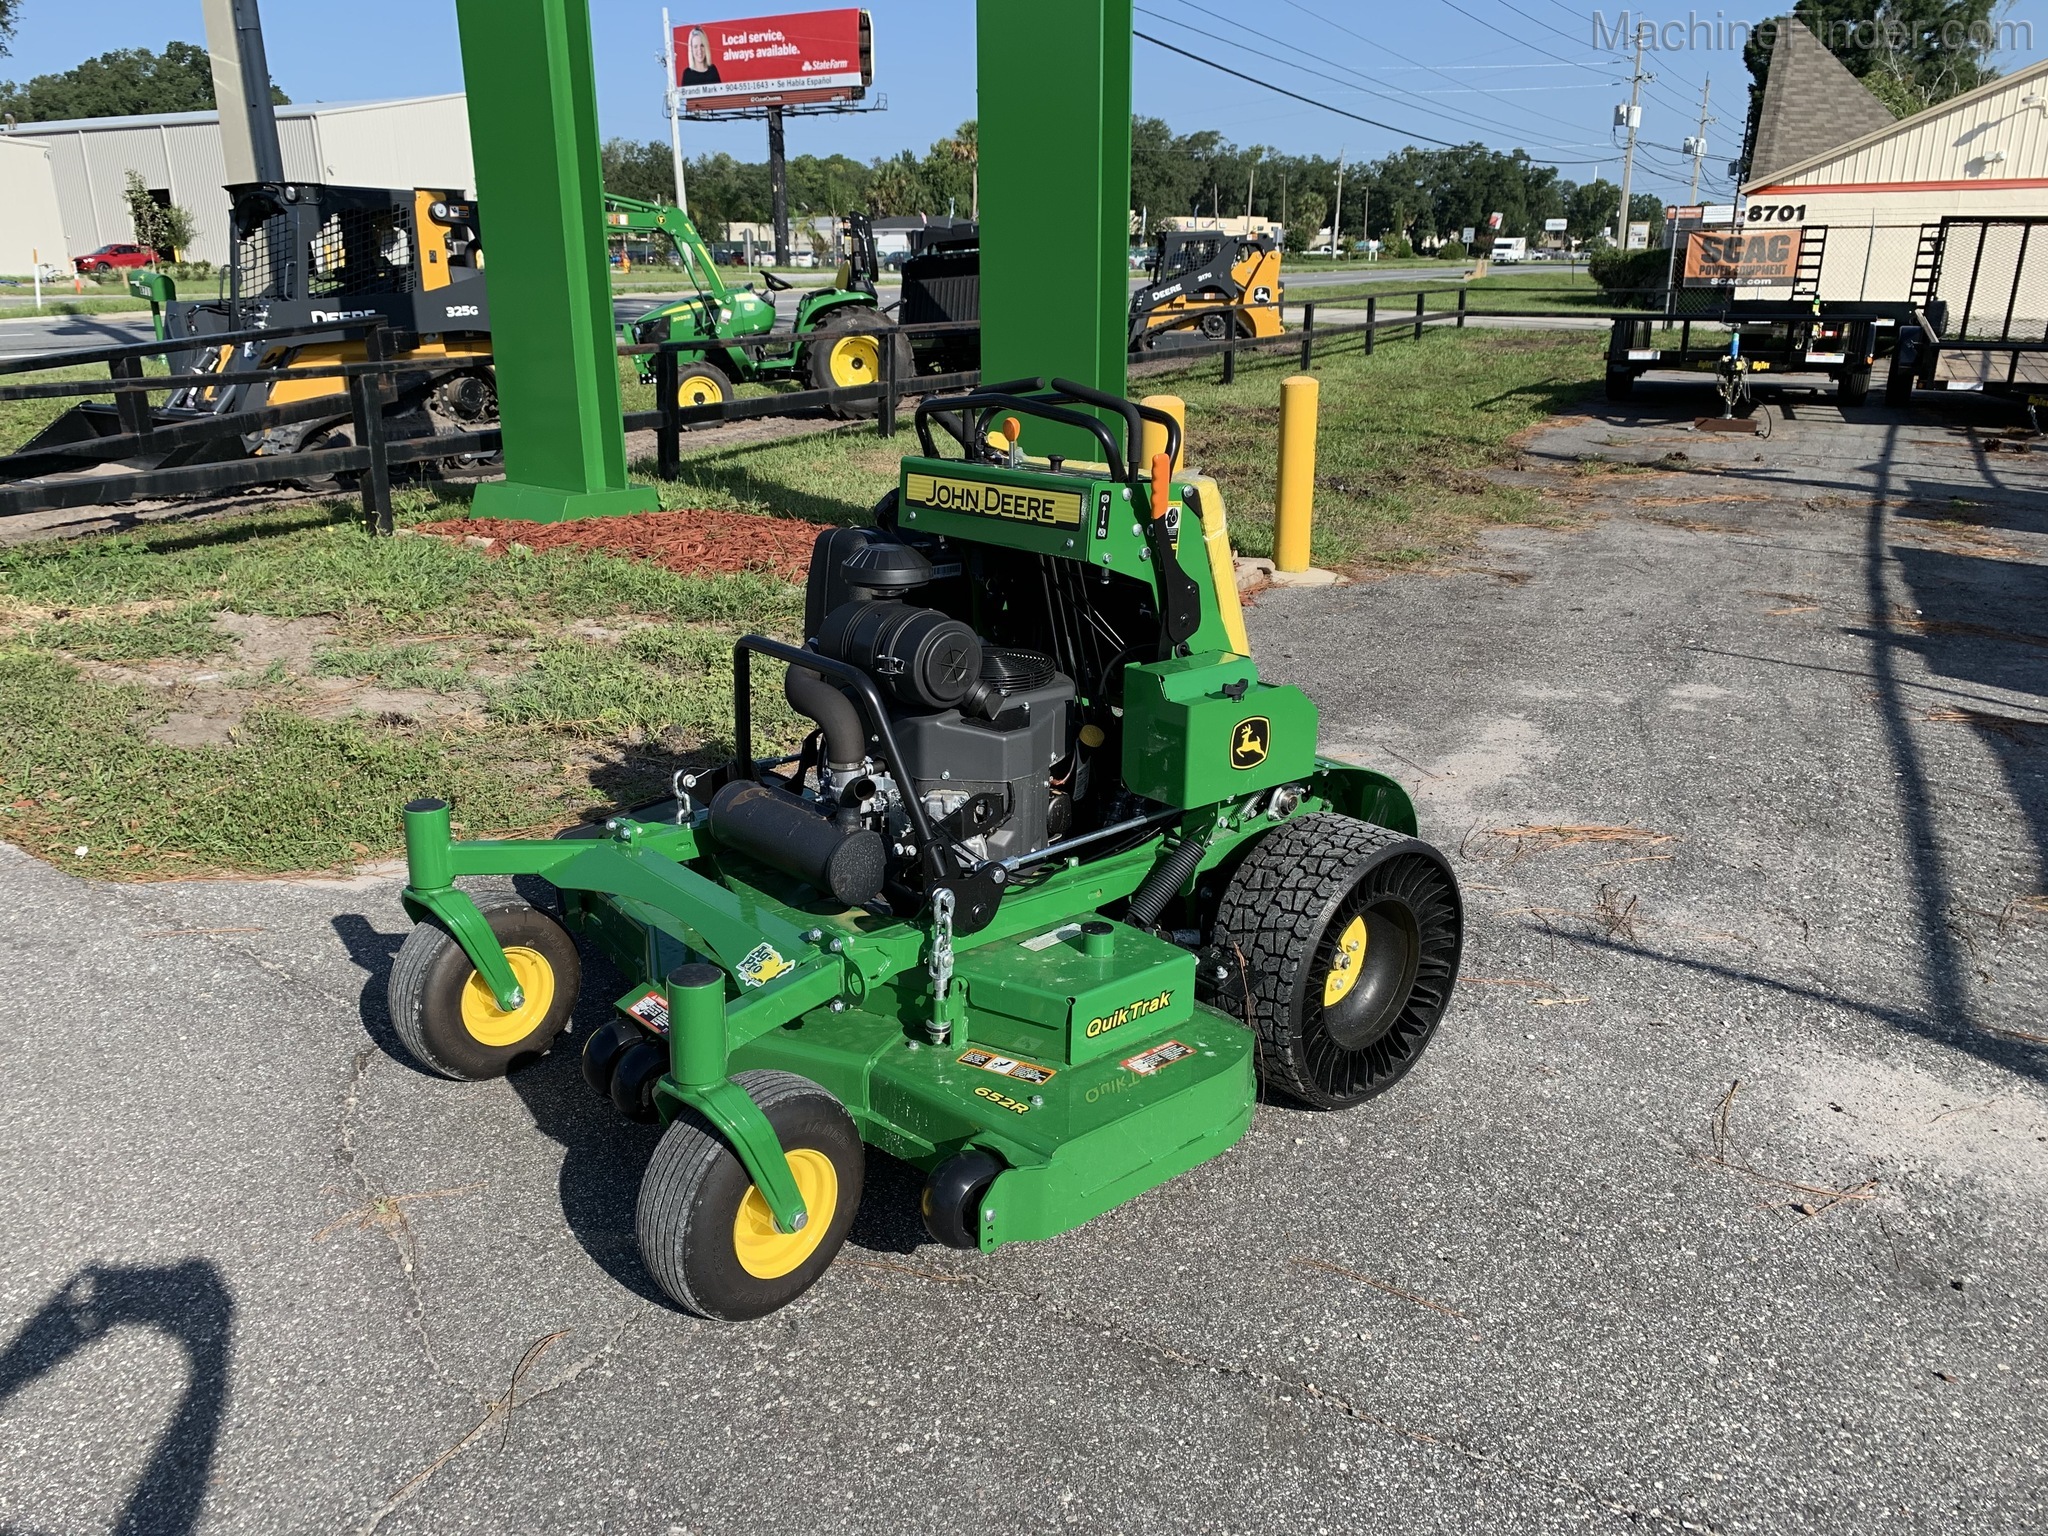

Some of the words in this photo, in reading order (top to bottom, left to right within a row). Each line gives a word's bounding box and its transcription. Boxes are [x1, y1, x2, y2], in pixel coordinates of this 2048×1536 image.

[721, 31, 747, 46] Local
[748, 28, 785, 43] service,
[723, 48, 755, 62] always
[756, 43, 800, 57] available.
[681, 86, 700, 96] Brandi
[702, 83, 718, 93] Mark
[725, 81, 769, 92] 904-551-1643
[777, 80, 786, 88] Se
[787, 78, 805, 88] Habla
[806, 76, 832, 87] Español
[1747, 205, 1806, 222] 8701
[1703, 235, 1791, 263] SCAG
[1699, 265, 1732, 276] POWER
[1733, 264, 1787, 276] EQUIPMENT
[1710, 277, 1772, 286] SCAG.com
[1152, 283, 1182, 301] DEERE
[445, 305, 479, 317] 325G
[926, 480, 979, 511] JOHN
[984, 486, 1056, 521] DEERE
[740, 956, 763, 973] Pro
[974, 1087, 1030, 1115] 652R
